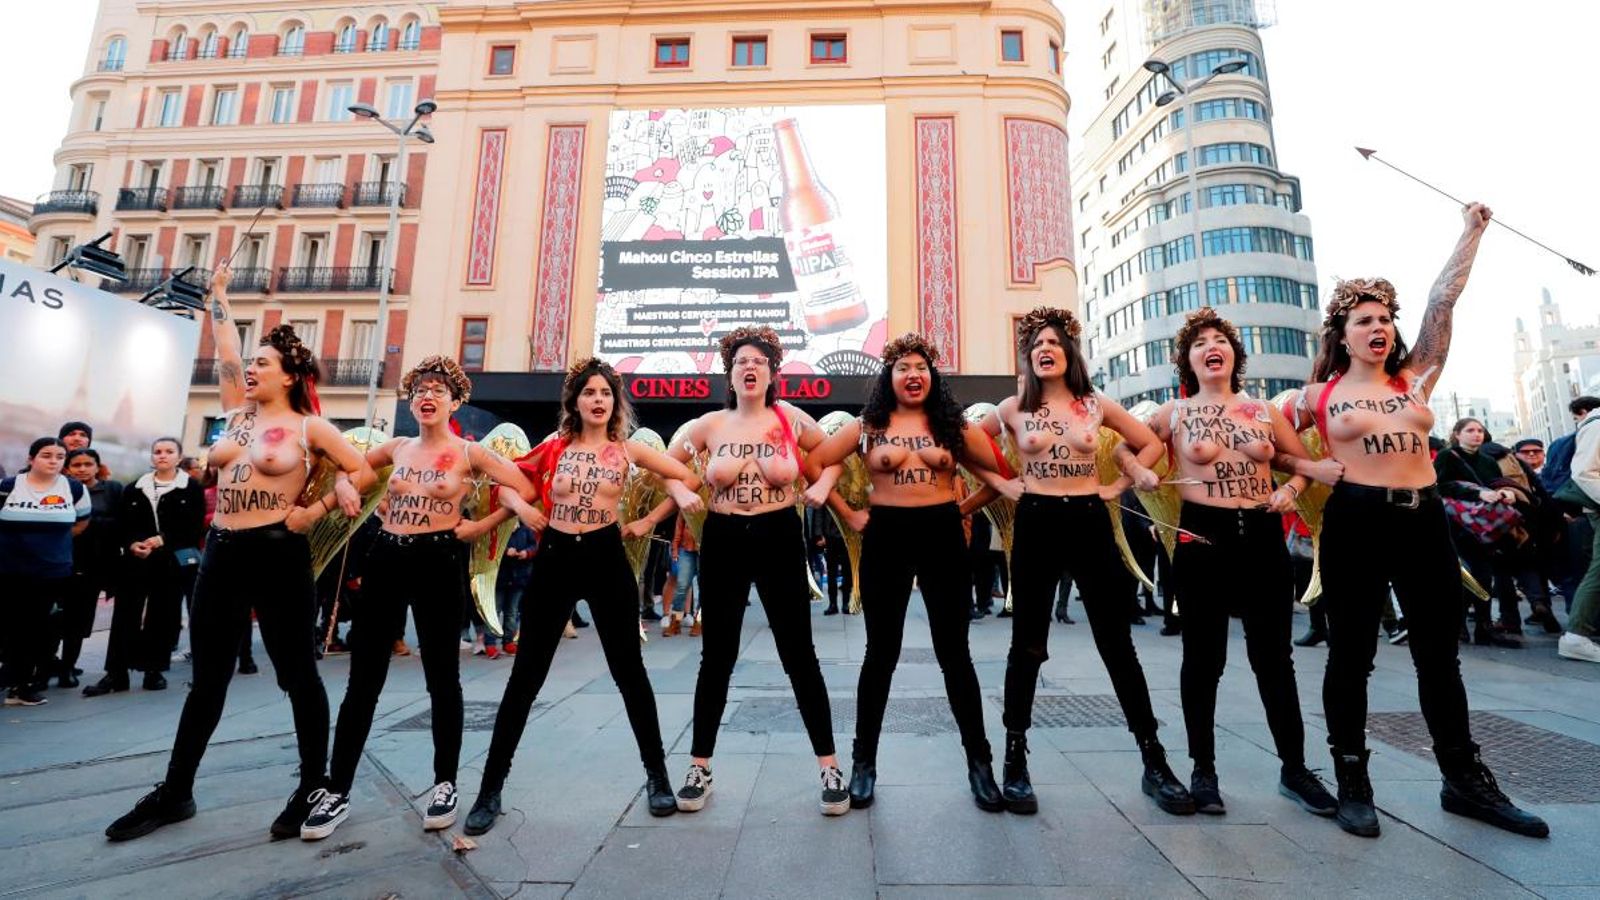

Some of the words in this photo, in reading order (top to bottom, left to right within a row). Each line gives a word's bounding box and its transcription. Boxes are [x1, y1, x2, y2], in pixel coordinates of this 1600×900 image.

[619, 251, 667, 264] Mahou
[670, 250, 712, 264] Cinco
[715, 250, 779, 264] Estrellas
[692, 266, 750, 279] Session
[752, 266, 779, 278] IPA
[633, 311, 680, 321] MAESTROS
[681, 310, 738, 320] CERVECEROS
[739, 309, 752, 318] DE
[753, 308, 786, 318] MAHOU
[603, 339, 650, 348] MAESTROS
[651, 337, 709, 347] CERVECEROS
[631, 379, 710, 399] CINES
[779, 378, 832, 399] LAO
[1187, 404, 1226, 416] HOY
[1329, 393, 1416, 417] MACHISM
[717, 443, 788, 459] CUPIDO
[1048, 443, 1071, 460] 10
[1363, 432, 1424, 455] MATA
[560, 451, 597, 464] AYER
[231, 463, 253, 483] 10
[395, 467, 446, 484] AMOR
[557, 463, 580, 477] ERA
[894, 468, 937, 486] MATA
[1215, 461, 1258, 480] BAJO
[738, 472, 763, 485] HA
[569, 478, 600, 496] HOY
[715, 486, 786, 504] MUERTO
[1203, 477, 1273, 498] TIERRA
[579, 496, 593, 508] ES
[389, 511, 431, 526] MATA
